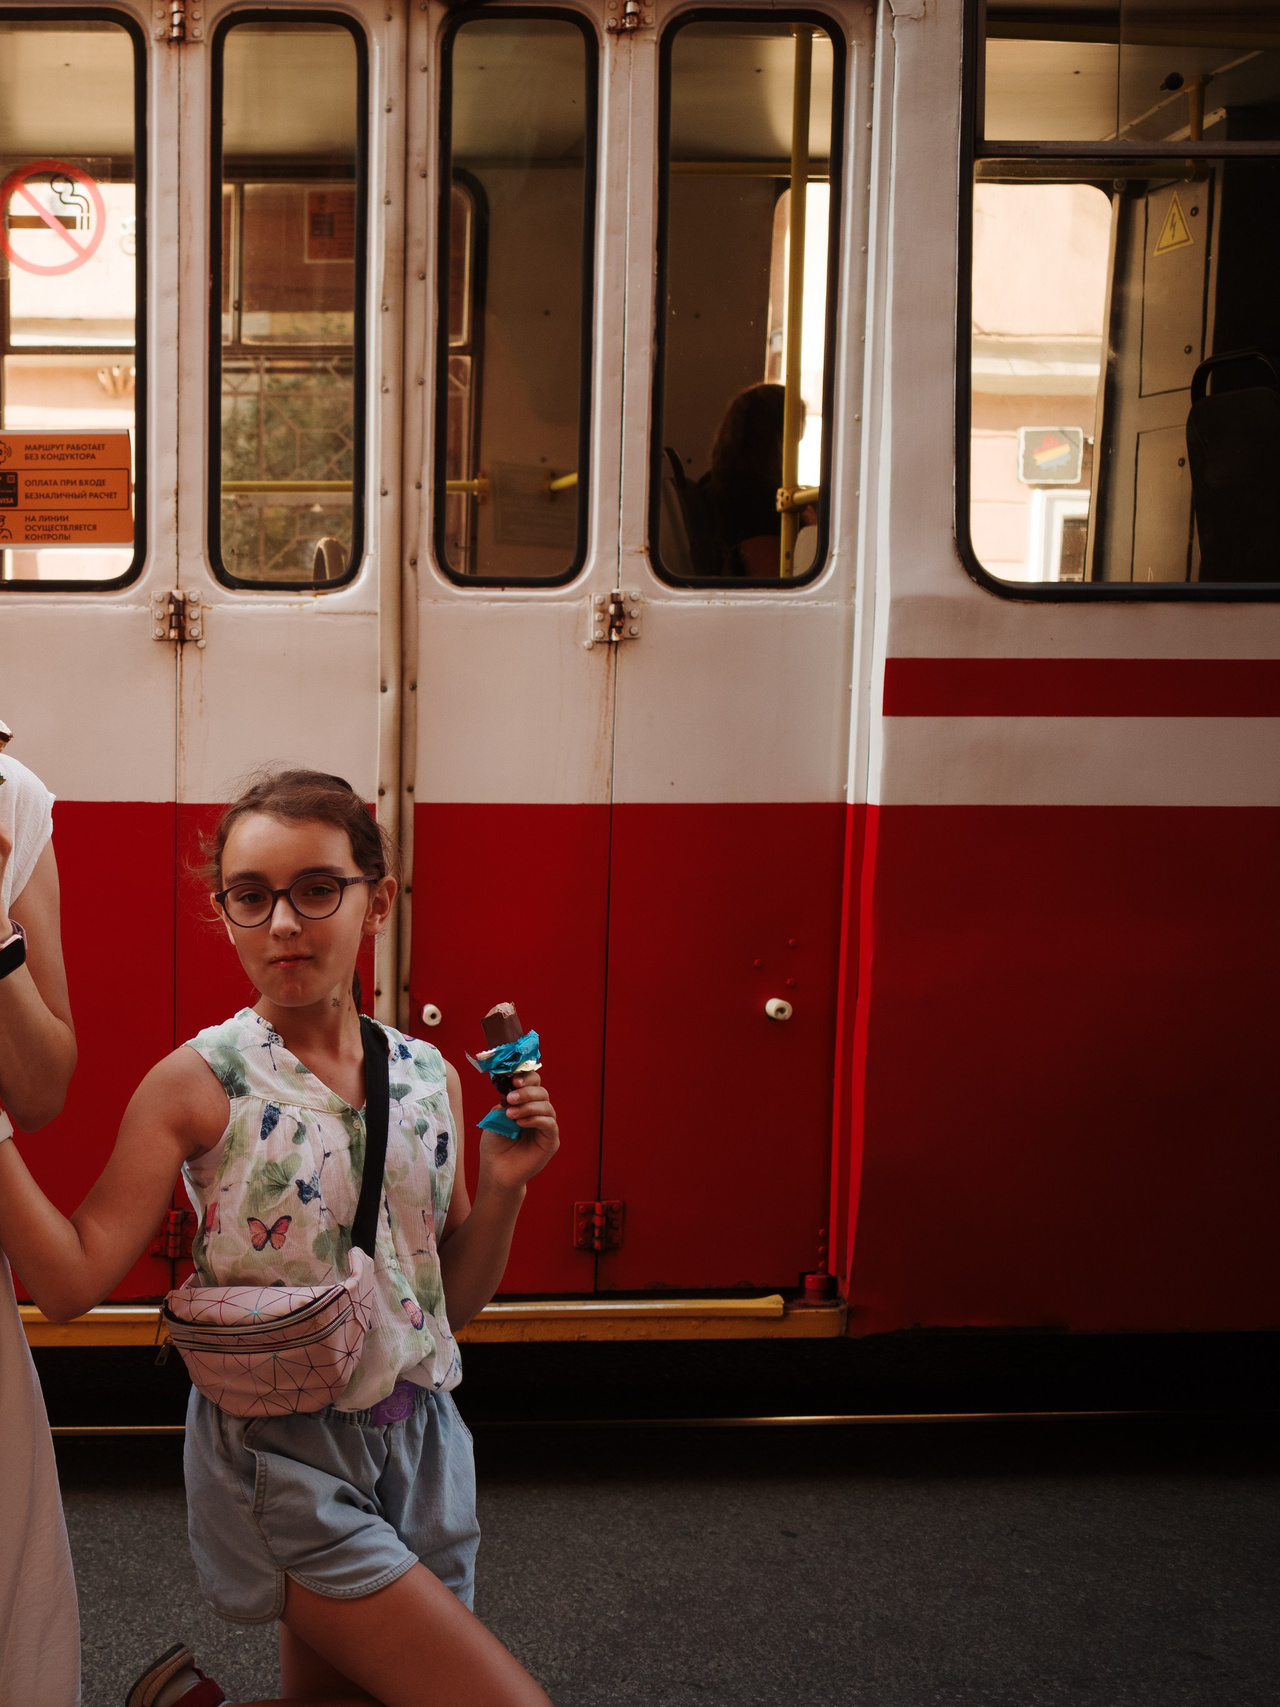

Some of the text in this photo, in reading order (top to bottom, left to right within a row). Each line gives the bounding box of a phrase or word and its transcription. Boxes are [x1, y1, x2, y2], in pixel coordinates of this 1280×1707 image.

[66, 443, 106, 451] РАБОТАЕТ
[40, 453, 96, 461] КОНДУКТОРА
[78, 479, 106, 487] ВХОДЕ
[24, 490, 87, 499] БЕЗНАЛИЧНЫЙ
[88, 491, 117, 499] РАСЧЕТ
[24, 524, 97, 532] ОСУЩЕСТВЛЯЕТСЯ
